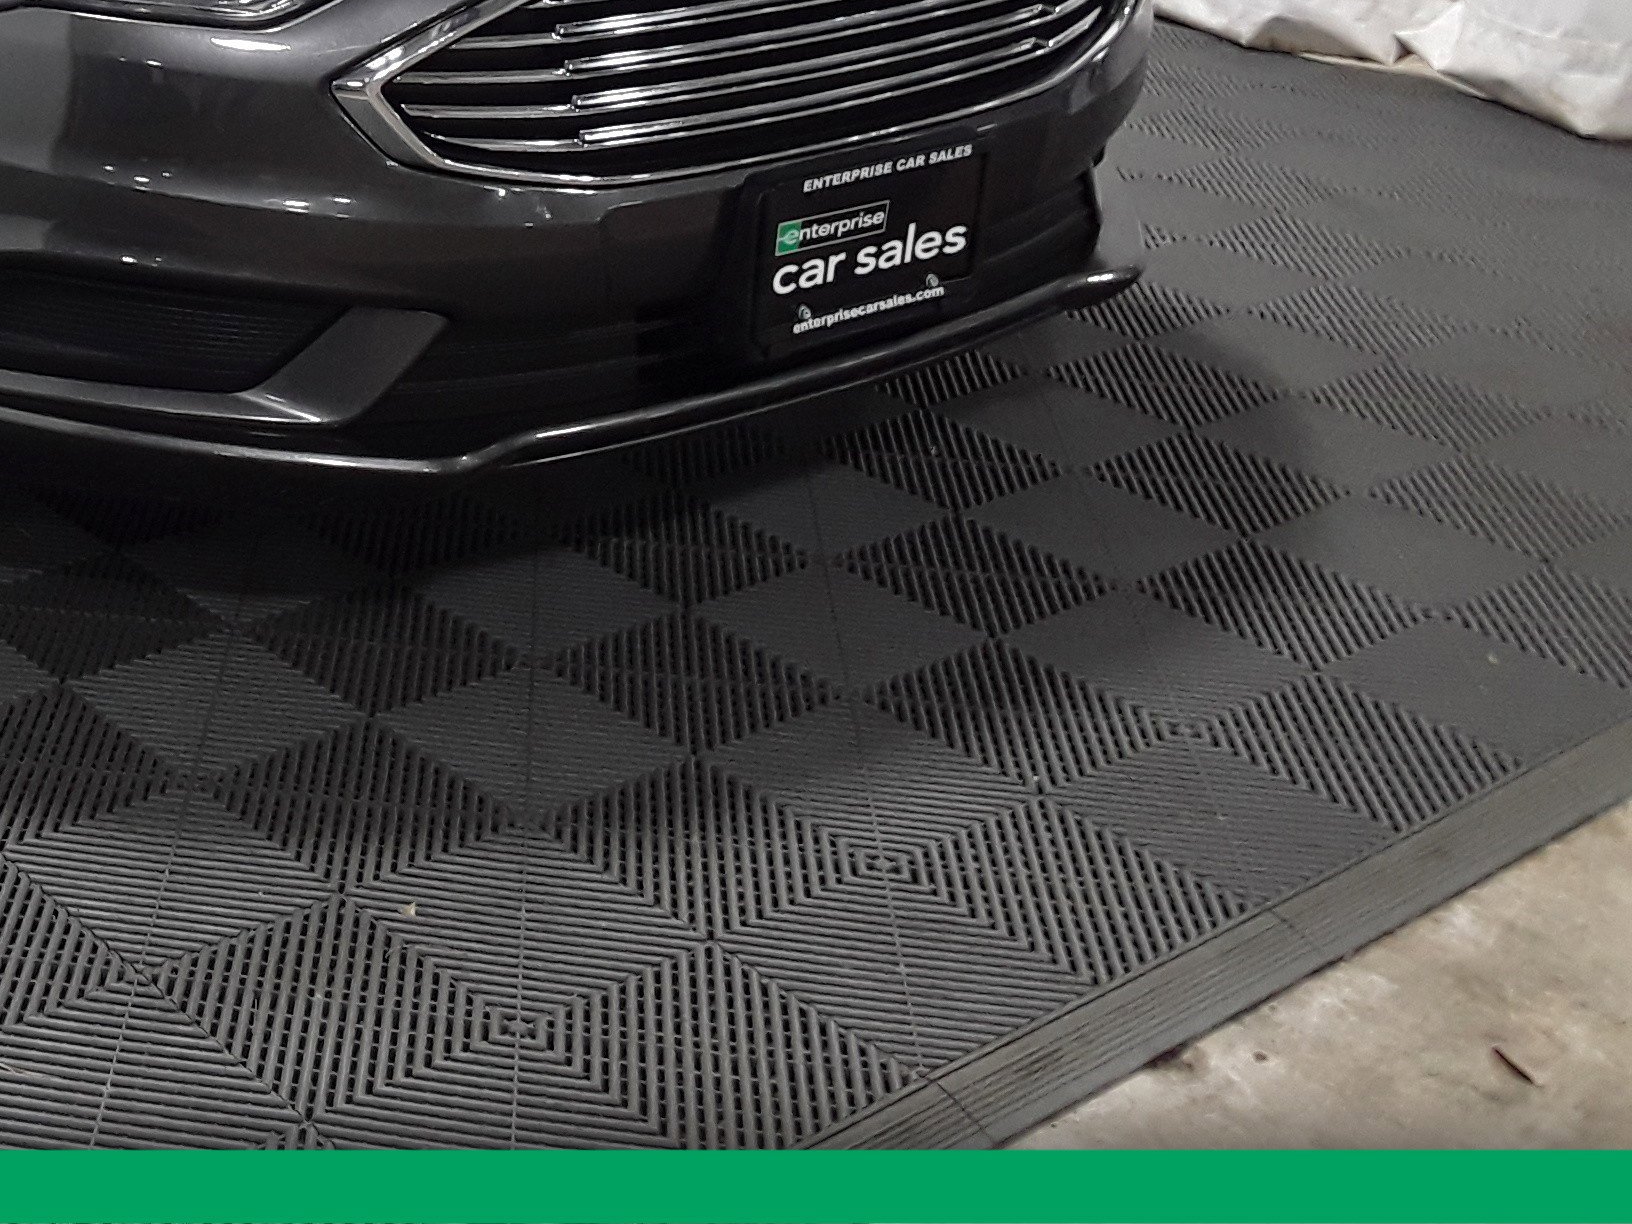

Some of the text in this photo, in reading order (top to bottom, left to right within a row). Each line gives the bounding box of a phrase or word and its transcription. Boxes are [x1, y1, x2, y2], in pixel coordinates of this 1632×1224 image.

[803, 144, 973, 193] ENTERPRISE CAR SALES
[777, 209, 885, 245] enterprise
[772, 222, 968, 295] car sales
[792, 285, 945, 335] enterprisecarsales.com
